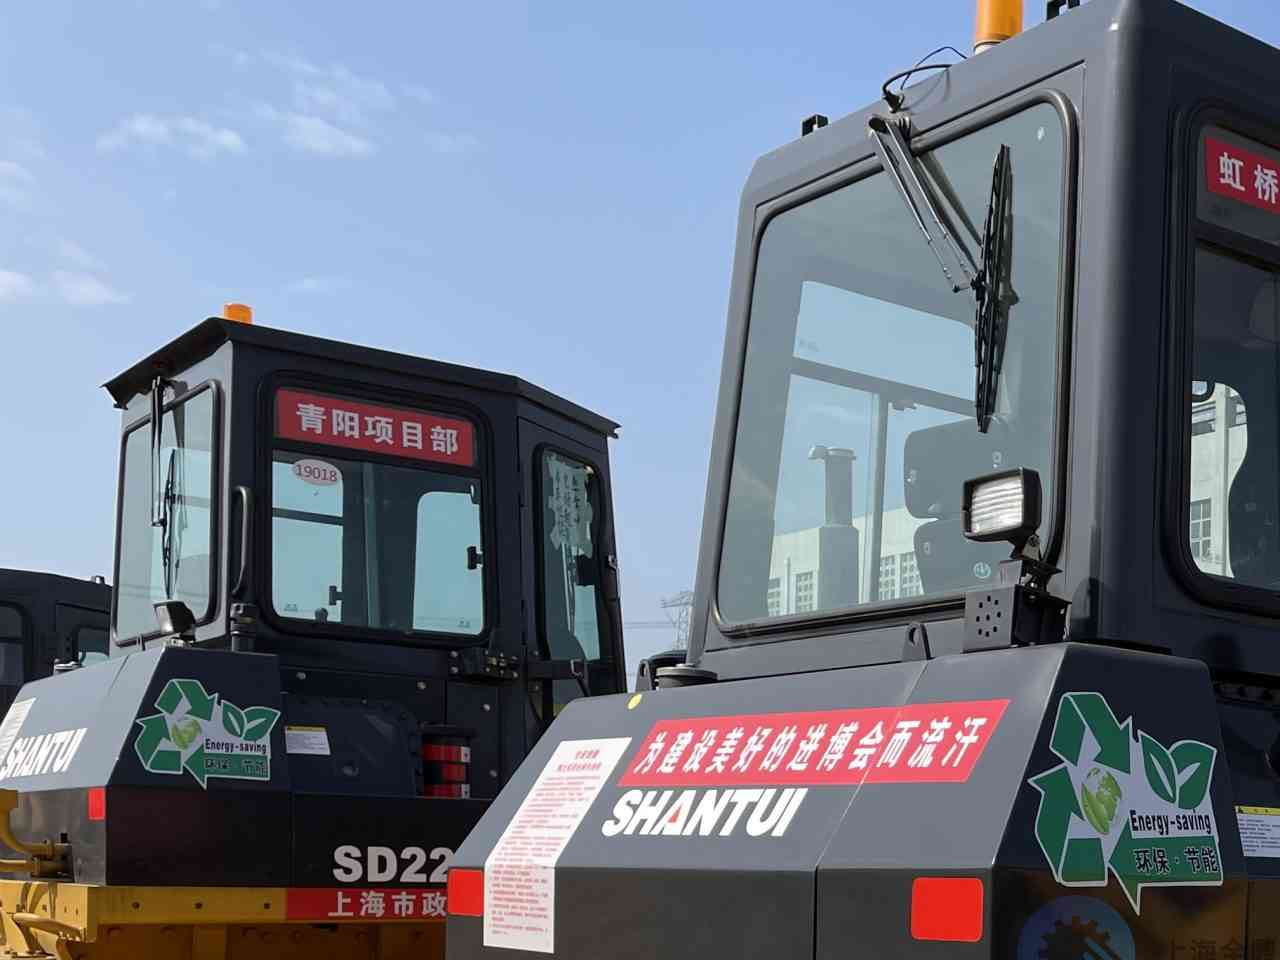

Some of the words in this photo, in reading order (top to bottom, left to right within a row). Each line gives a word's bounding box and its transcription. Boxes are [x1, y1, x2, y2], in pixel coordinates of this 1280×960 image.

[296, 403, 460, 456] 青阳项目部
[295, 463, 339, 484] 19018
[205, 739, 267, 754] Energy-saving
[633, 715, 989, 775] 为建设美好的进博会而流汗
[601, 787, 808, 837] SHANTUI
[1130, 809, 1212, 837] Energy-saving
[333, 845, 453, 882] SD22
[328, 890, 447, 918] 上海市政
